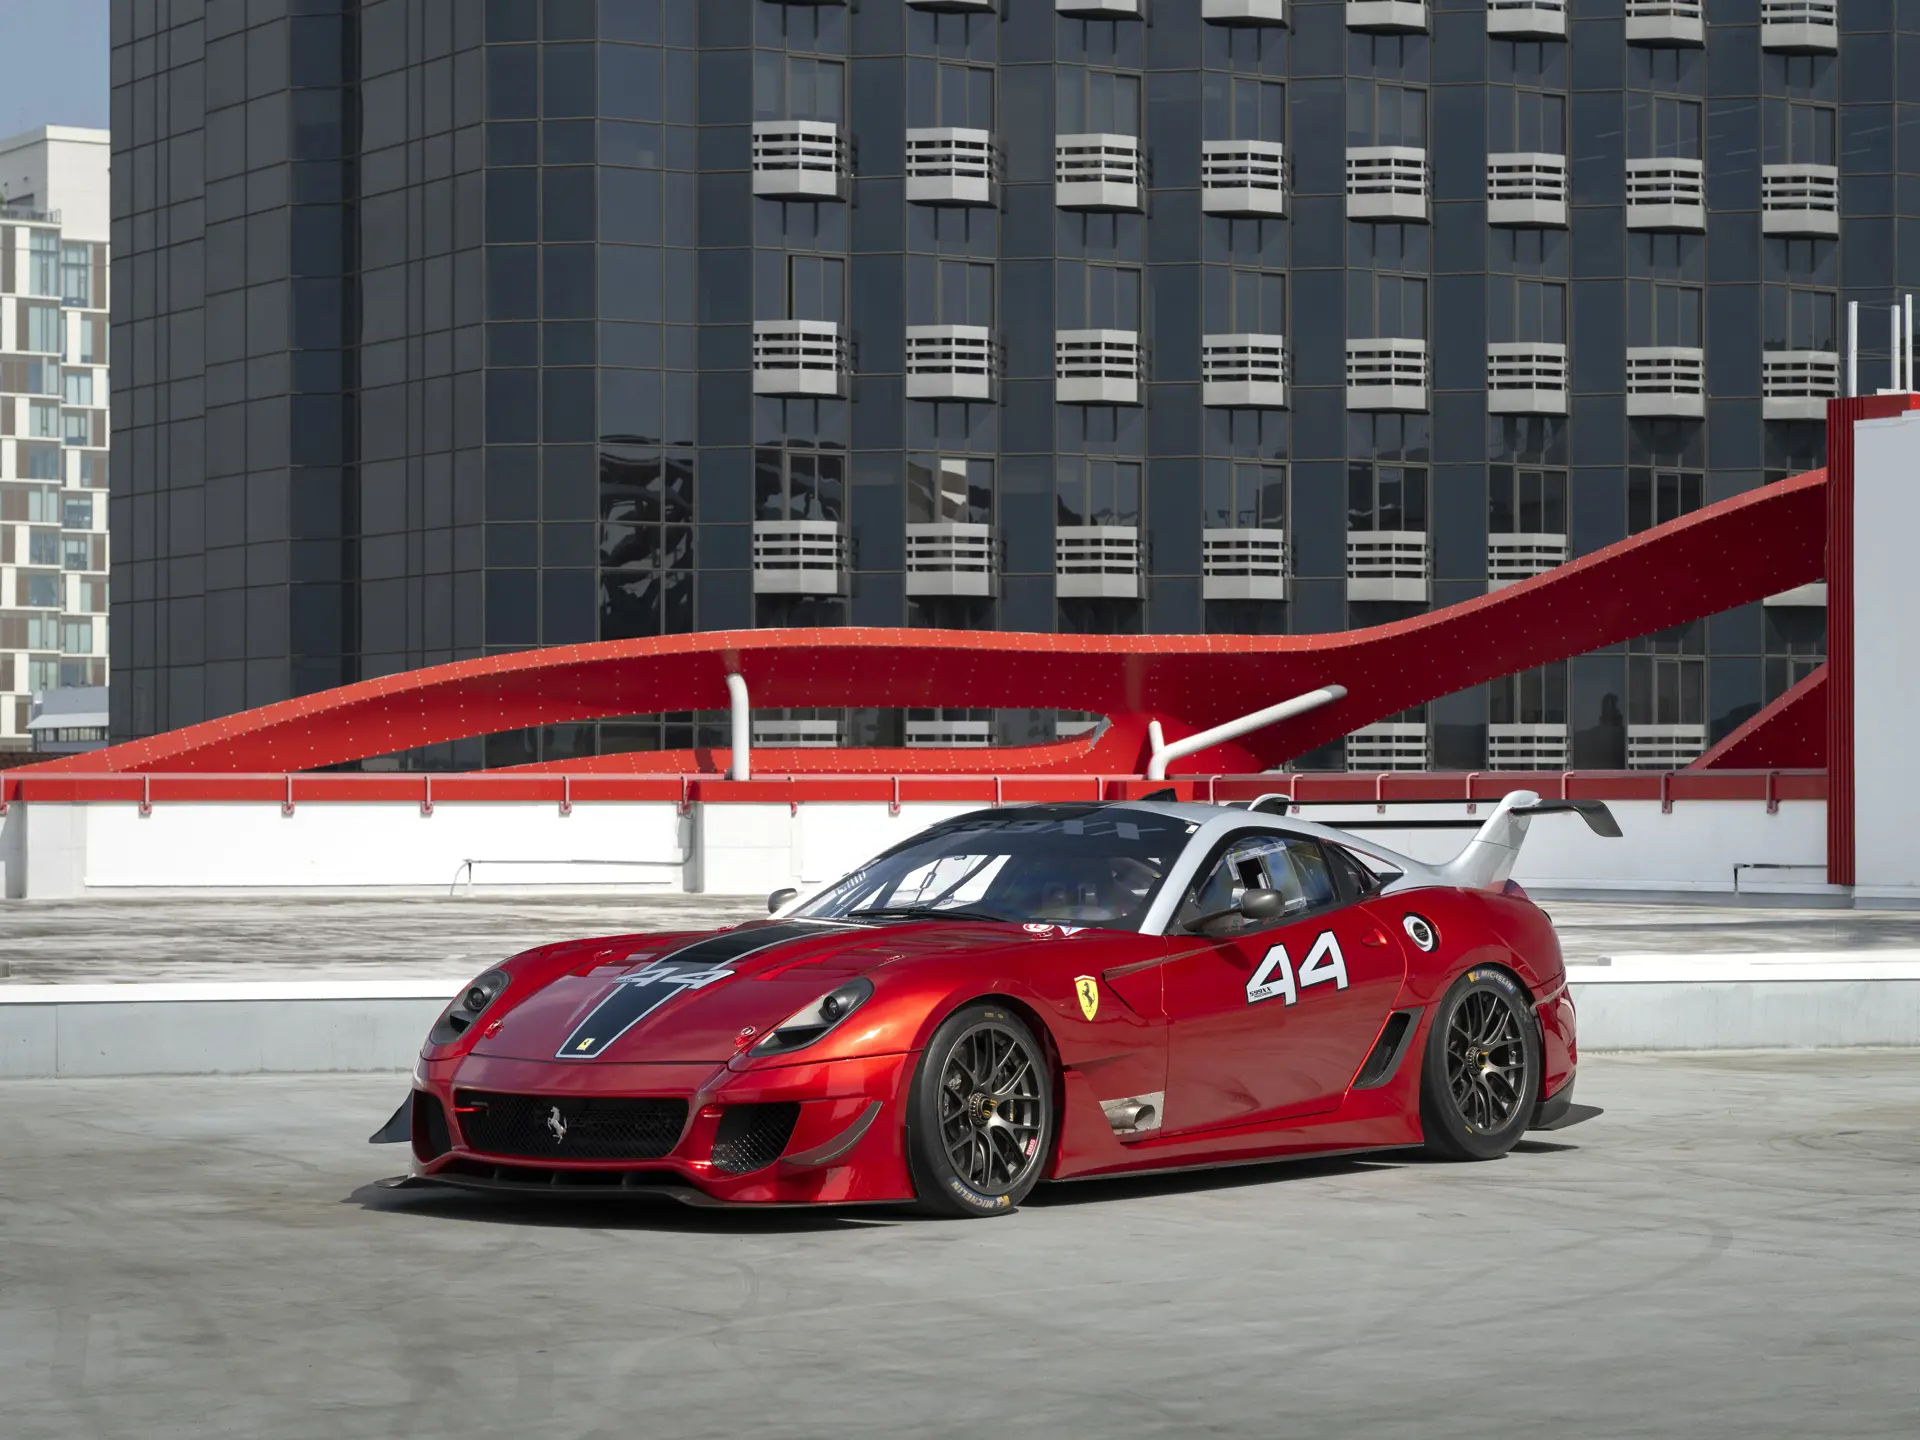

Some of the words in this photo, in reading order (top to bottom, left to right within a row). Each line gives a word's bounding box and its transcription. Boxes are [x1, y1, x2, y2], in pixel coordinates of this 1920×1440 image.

[612, 967, 736, 990] 44
[1245, 928, 1349, 1007] 44
[1249, 986, 1272, 997] 599XX
[1480, 970, 1514, 991] MICHELIN
[951, 1181, 995, 1208] MICHELIN
